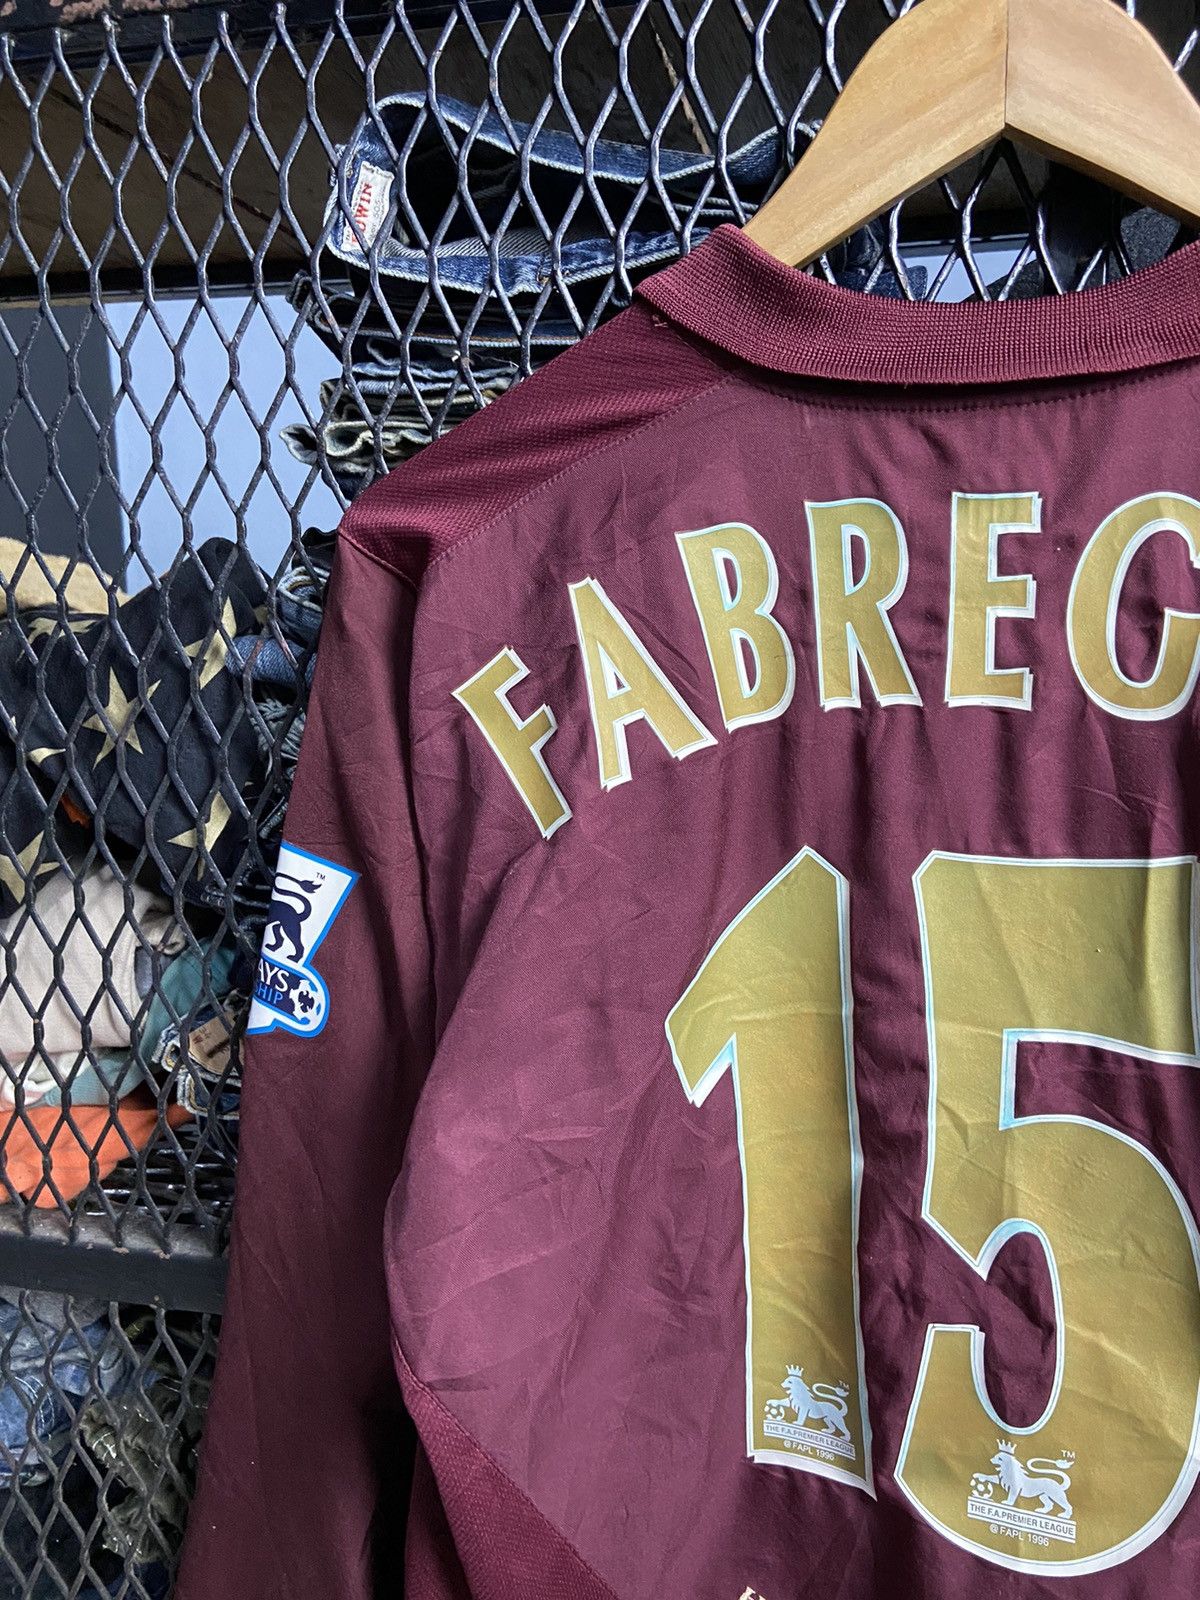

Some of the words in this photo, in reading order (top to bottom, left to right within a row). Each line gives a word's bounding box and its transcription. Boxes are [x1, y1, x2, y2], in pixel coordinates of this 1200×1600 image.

[451, 491, 1200, 840] FABREG
[255, 982, 283, 1004] HIP
[665, 845, 1200, 1577] 15
[766, 1424, 780, 1433] THE
[825, 1439, 854, 1454] LEAGUE
[816, 1449, 835, 1460] 1996
[1061, 1449, 1076, 1459] TM
[970, 1503, 986, 1514] THE
[1039, 1521, 1074, 1536] LEAGUE
[1027, 1533, 1050, 1546] 1996
